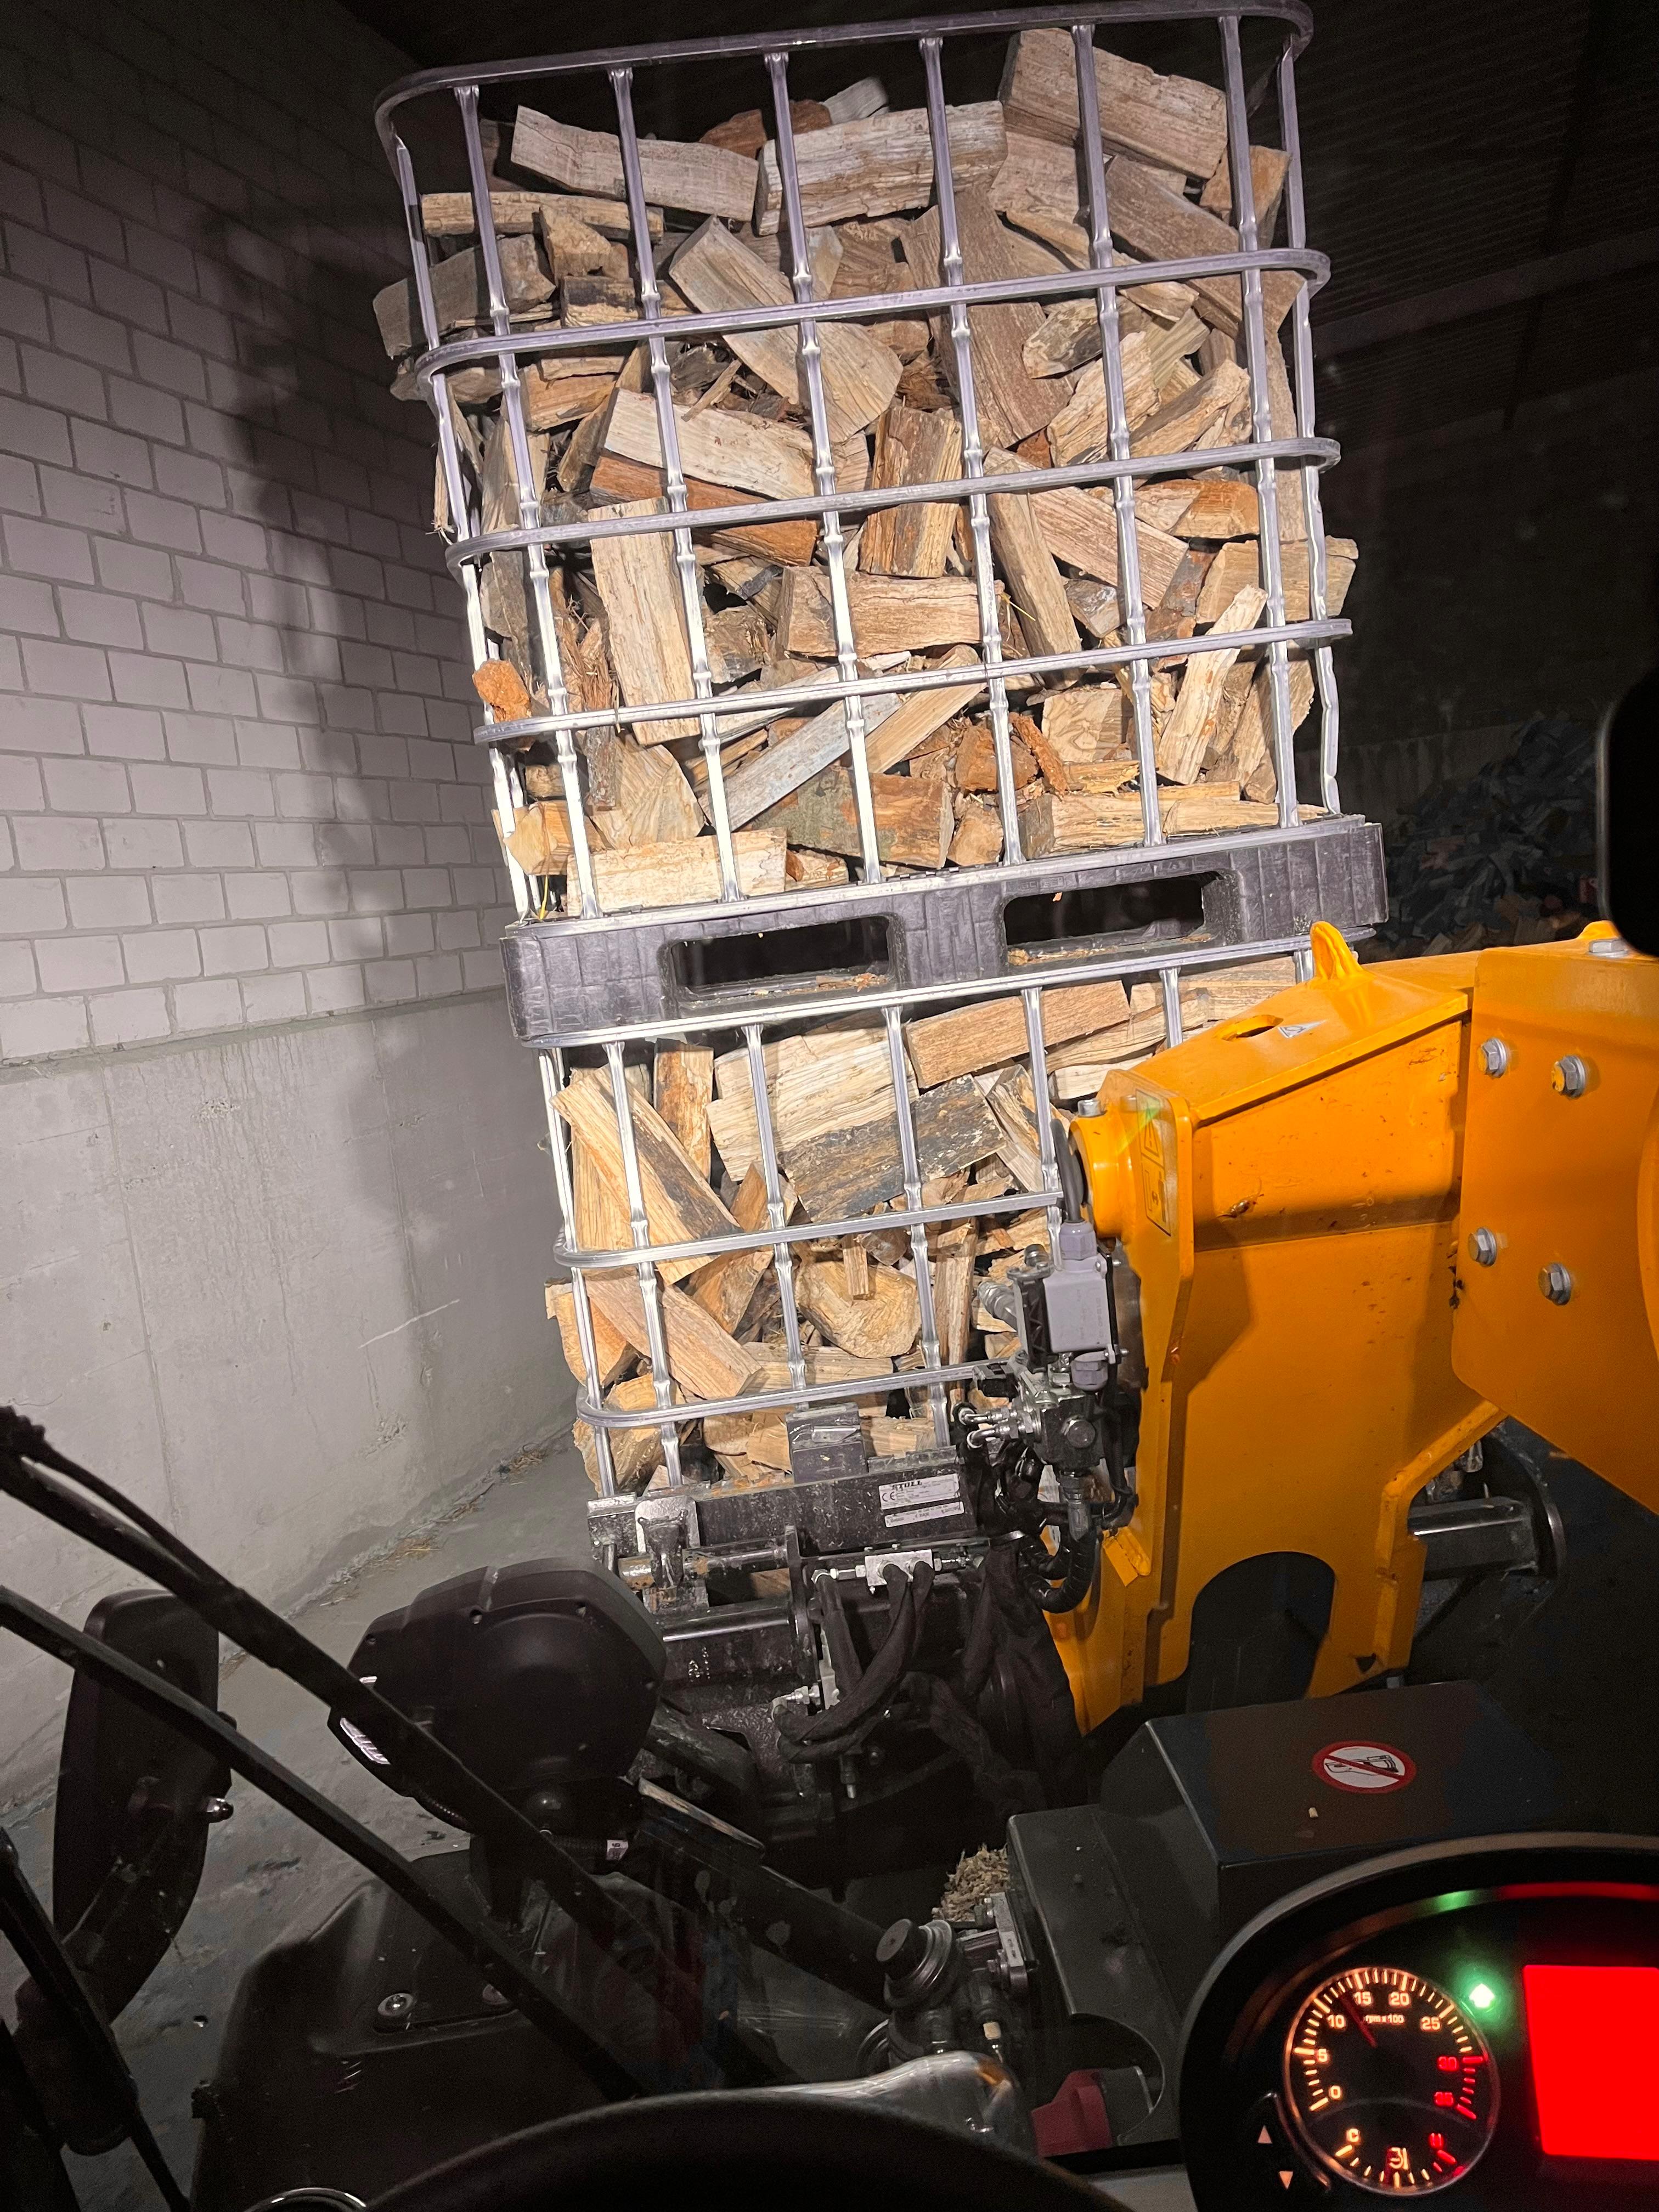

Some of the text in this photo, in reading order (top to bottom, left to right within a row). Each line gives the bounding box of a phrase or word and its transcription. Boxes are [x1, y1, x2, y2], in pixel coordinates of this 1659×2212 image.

[1355, 1992, 1372, 2005] 15
[1389, 1992, 1410, 2006] 20
[1327, 2015, 1345, 2028] 10
[1365, 2015, 1381, 2023] rpm
[1421, 2017, 1441, 2030] 25
[1317, 2049, 1328, 2062] 5
[1437, 2056, 1458, 2071] 30
[1330, 2085, 1341, 2099] 0
[1347, 2128, 1360, 2142] C
